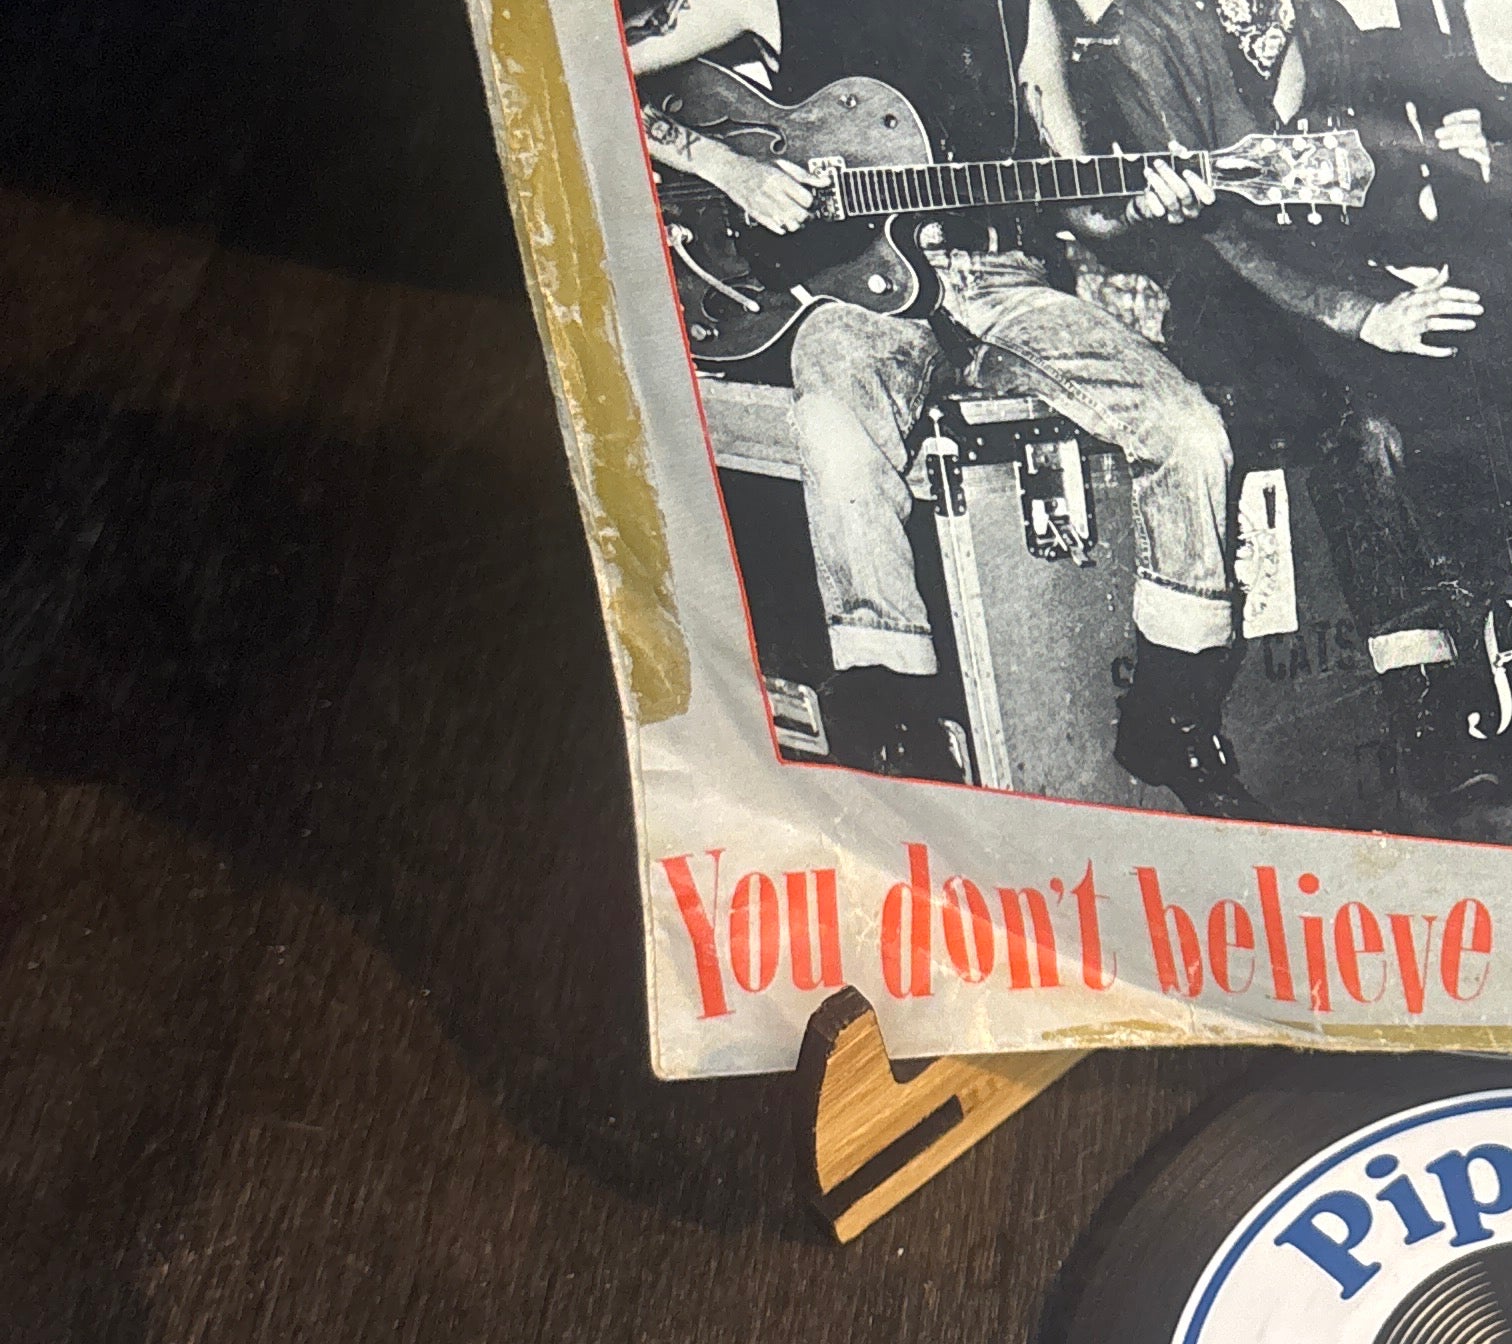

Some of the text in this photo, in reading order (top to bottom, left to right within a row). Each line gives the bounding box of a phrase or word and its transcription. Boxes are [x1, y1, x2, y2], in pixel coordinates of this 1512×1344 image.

[656, 847, 847, 1021] You
[880, 841, 1118, 1001] don't
[1130, 864, 1493, 1015] believe
